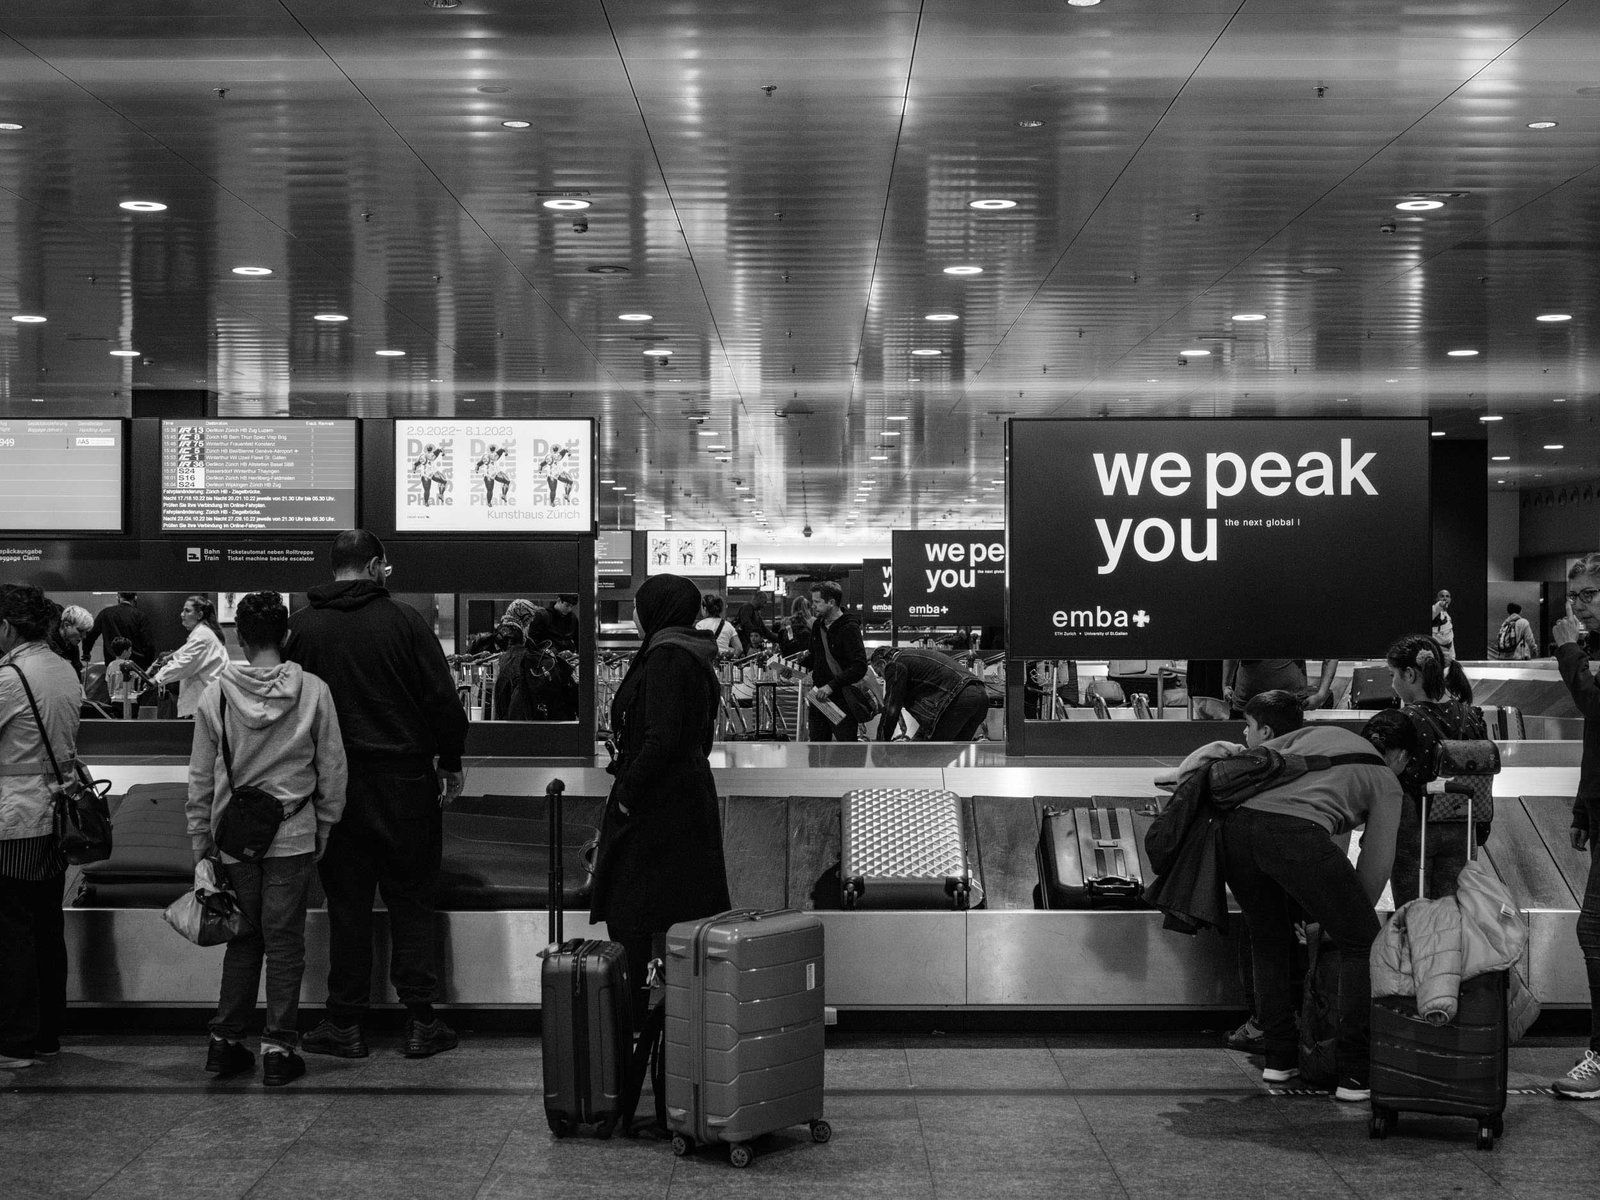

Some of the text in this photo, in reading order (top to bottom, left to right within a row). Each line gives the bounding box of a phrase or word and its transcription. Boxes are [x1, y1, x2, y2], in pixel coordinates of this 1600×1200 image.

[466, 426, 513, 436] 8.1.2023
[1093, 438, 1379, 510] we peak
[487, 510, 580, 520] Kunsthaus Zürich
[1266, 518, 1294, 528] global
[925, 543, 1005, 567] we pe
[1094, 518, 1217, 574] you
[926, 569, 975, 592] you
[908, 604, 940, 614] emba
[1052, 606, 1128, 627] emba
